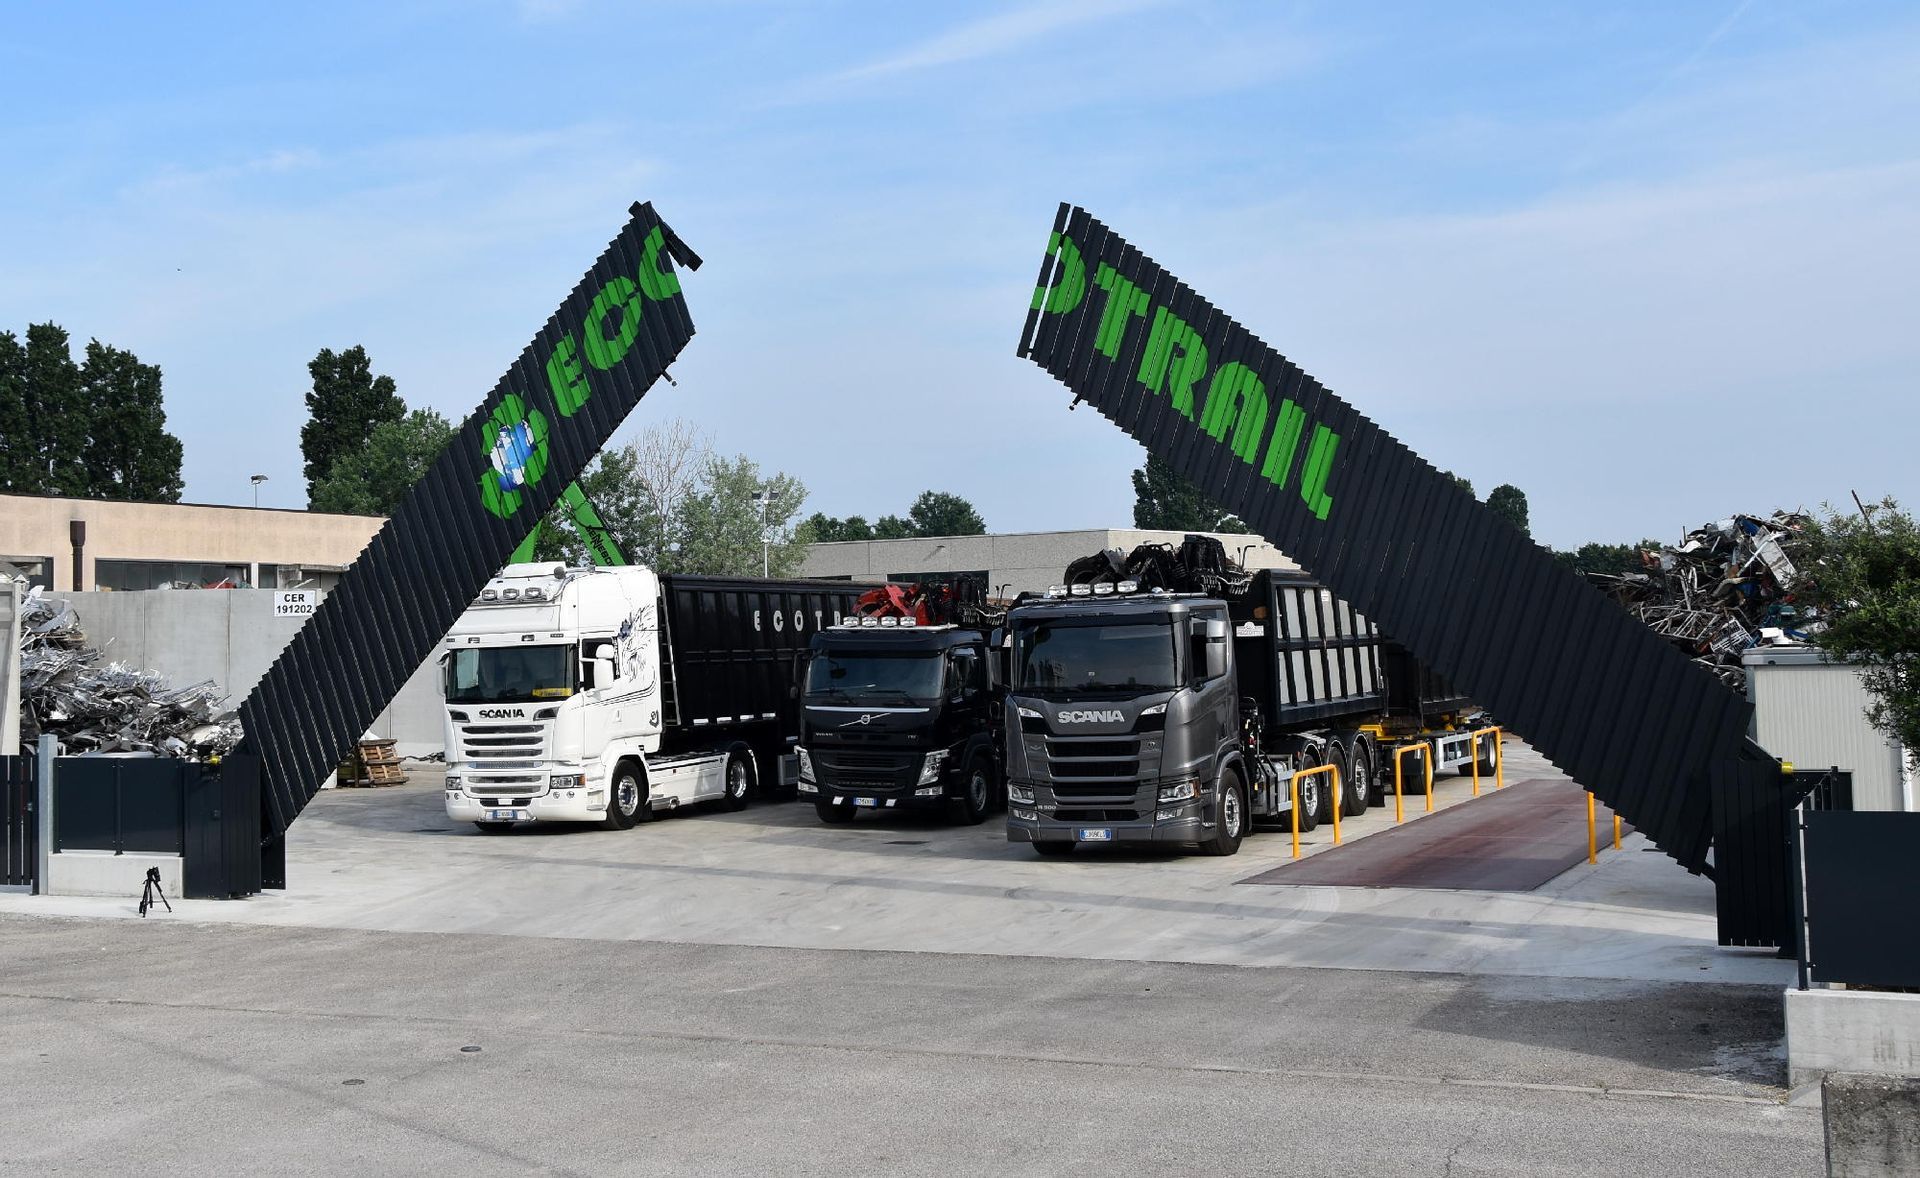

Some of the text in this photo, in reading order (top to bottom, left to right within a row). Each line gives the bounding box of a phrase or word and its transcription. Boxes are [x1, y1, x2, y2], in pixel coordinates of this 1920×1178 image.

[284, 593, 305, 603] CER
[276, 604, 312, 614] 191202
[478, 708, 525, 719] SCANIA
[1057, 709, 1125, 724] SCANIA
